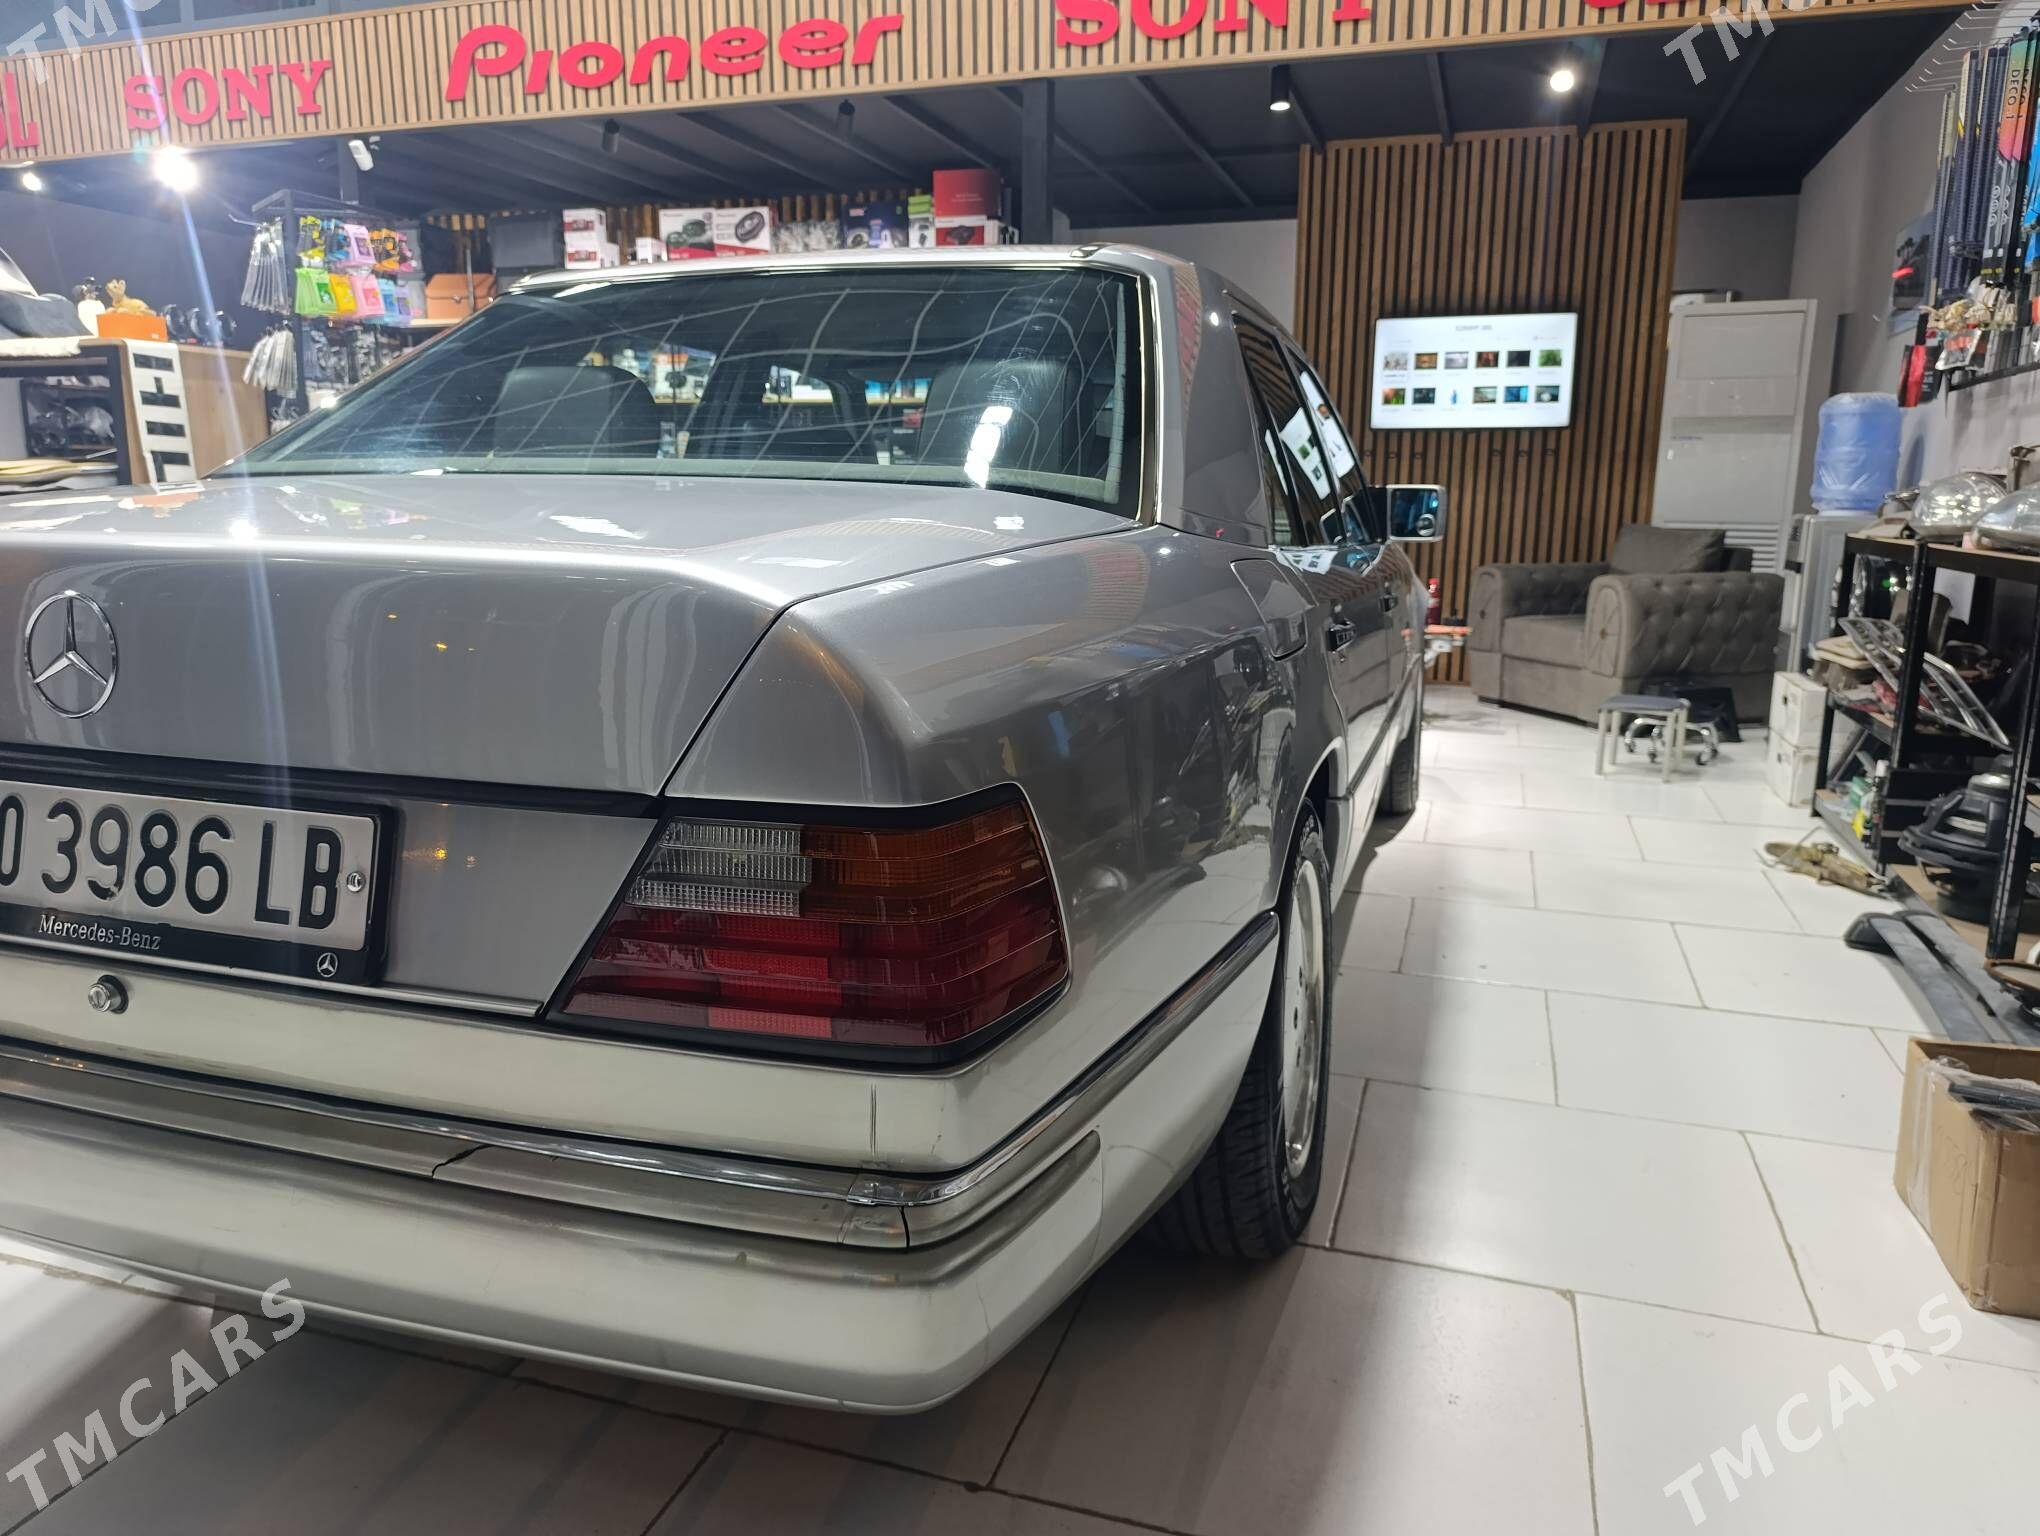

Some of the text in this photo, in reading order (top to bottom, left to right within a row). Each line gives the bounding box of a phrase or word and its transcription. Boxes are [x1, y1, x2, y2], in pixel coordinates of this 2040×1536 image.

[124, 60, 332, 132] SONY
[445, 14, 904, 101] Pioneer
[41, 801, 233, 914] 3986
[255, 821, 342, 929] LB
[38, 914, 161, 950] Mercedes-Benz
